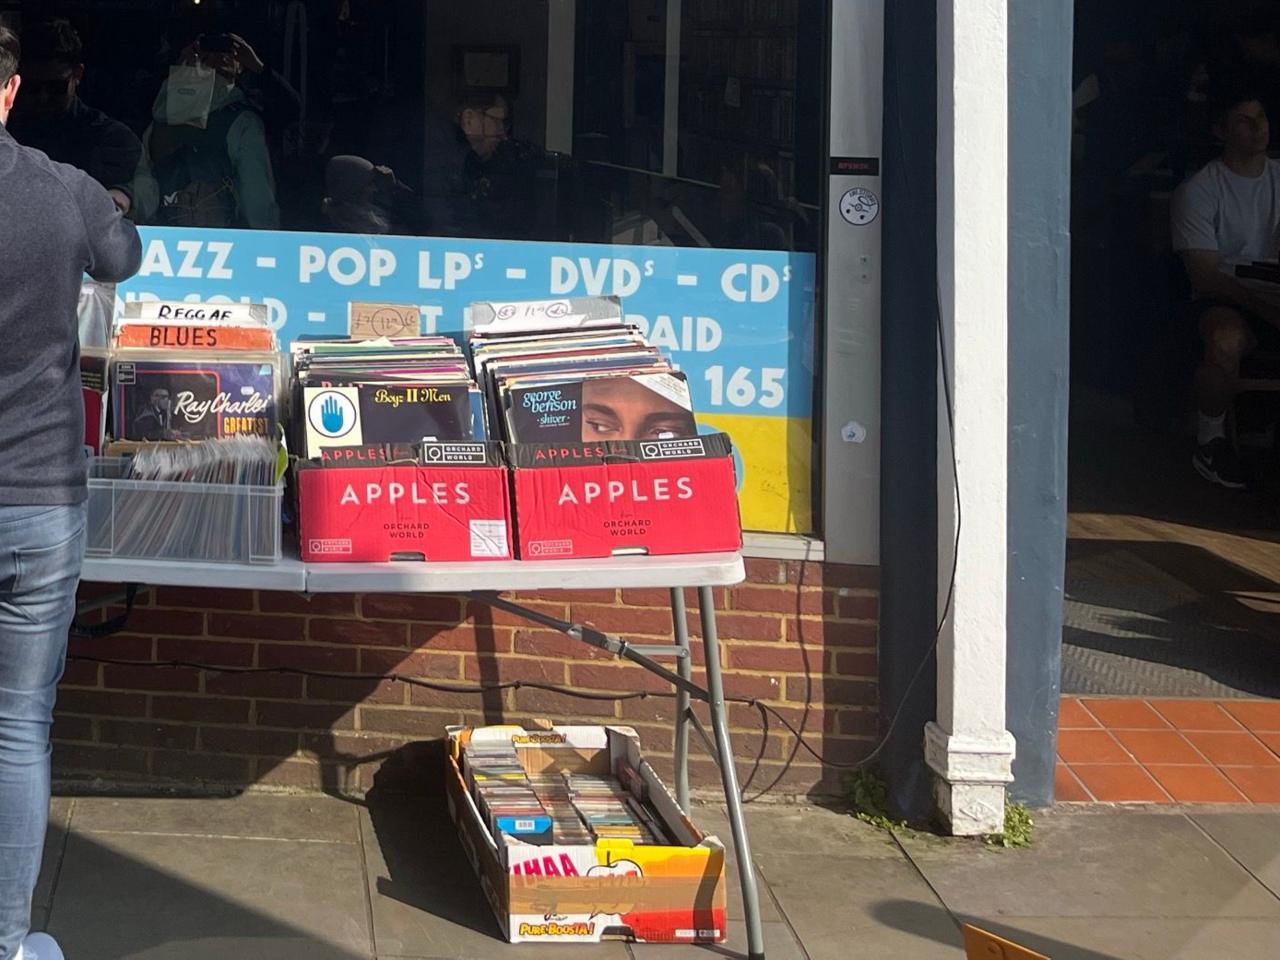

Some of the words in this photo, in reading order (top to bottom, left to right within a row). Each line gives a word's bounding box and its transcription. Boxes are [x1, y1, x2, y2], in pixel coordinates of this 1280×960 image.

[138, 239, 235, 280] AZZ
[299, 245, 397, 288] POP
[158, 305, 233, 321] REGGAE
[150, 327, 218, 347] BLUES
[703, 365, 787, 409] 165
[174, 391, 212, 423] Ray
[209, 389, 273, 414] Charles
[375, 389, 404, 408] Boyz
[406, 389, 419, 401] II
[421, 389, 451, 402] Men
[522, 390, 562, 408] george
[531, 399, 577, 413] benson
[223, 416, 269, 434] GREATEST
[322, 447, 385, 461] APPLES
[535, 447, 606, 460] APPLES
[340, 482, 471, 505] APPLES
[558, 476, 694, 506] APPLES
[383, 523, 430, 531] ORCHARD
[603, 519, 652, 529] ORCHARD
[609, 528, 647, 537] WORLD
[389, 531, 425, 539] WORLD
